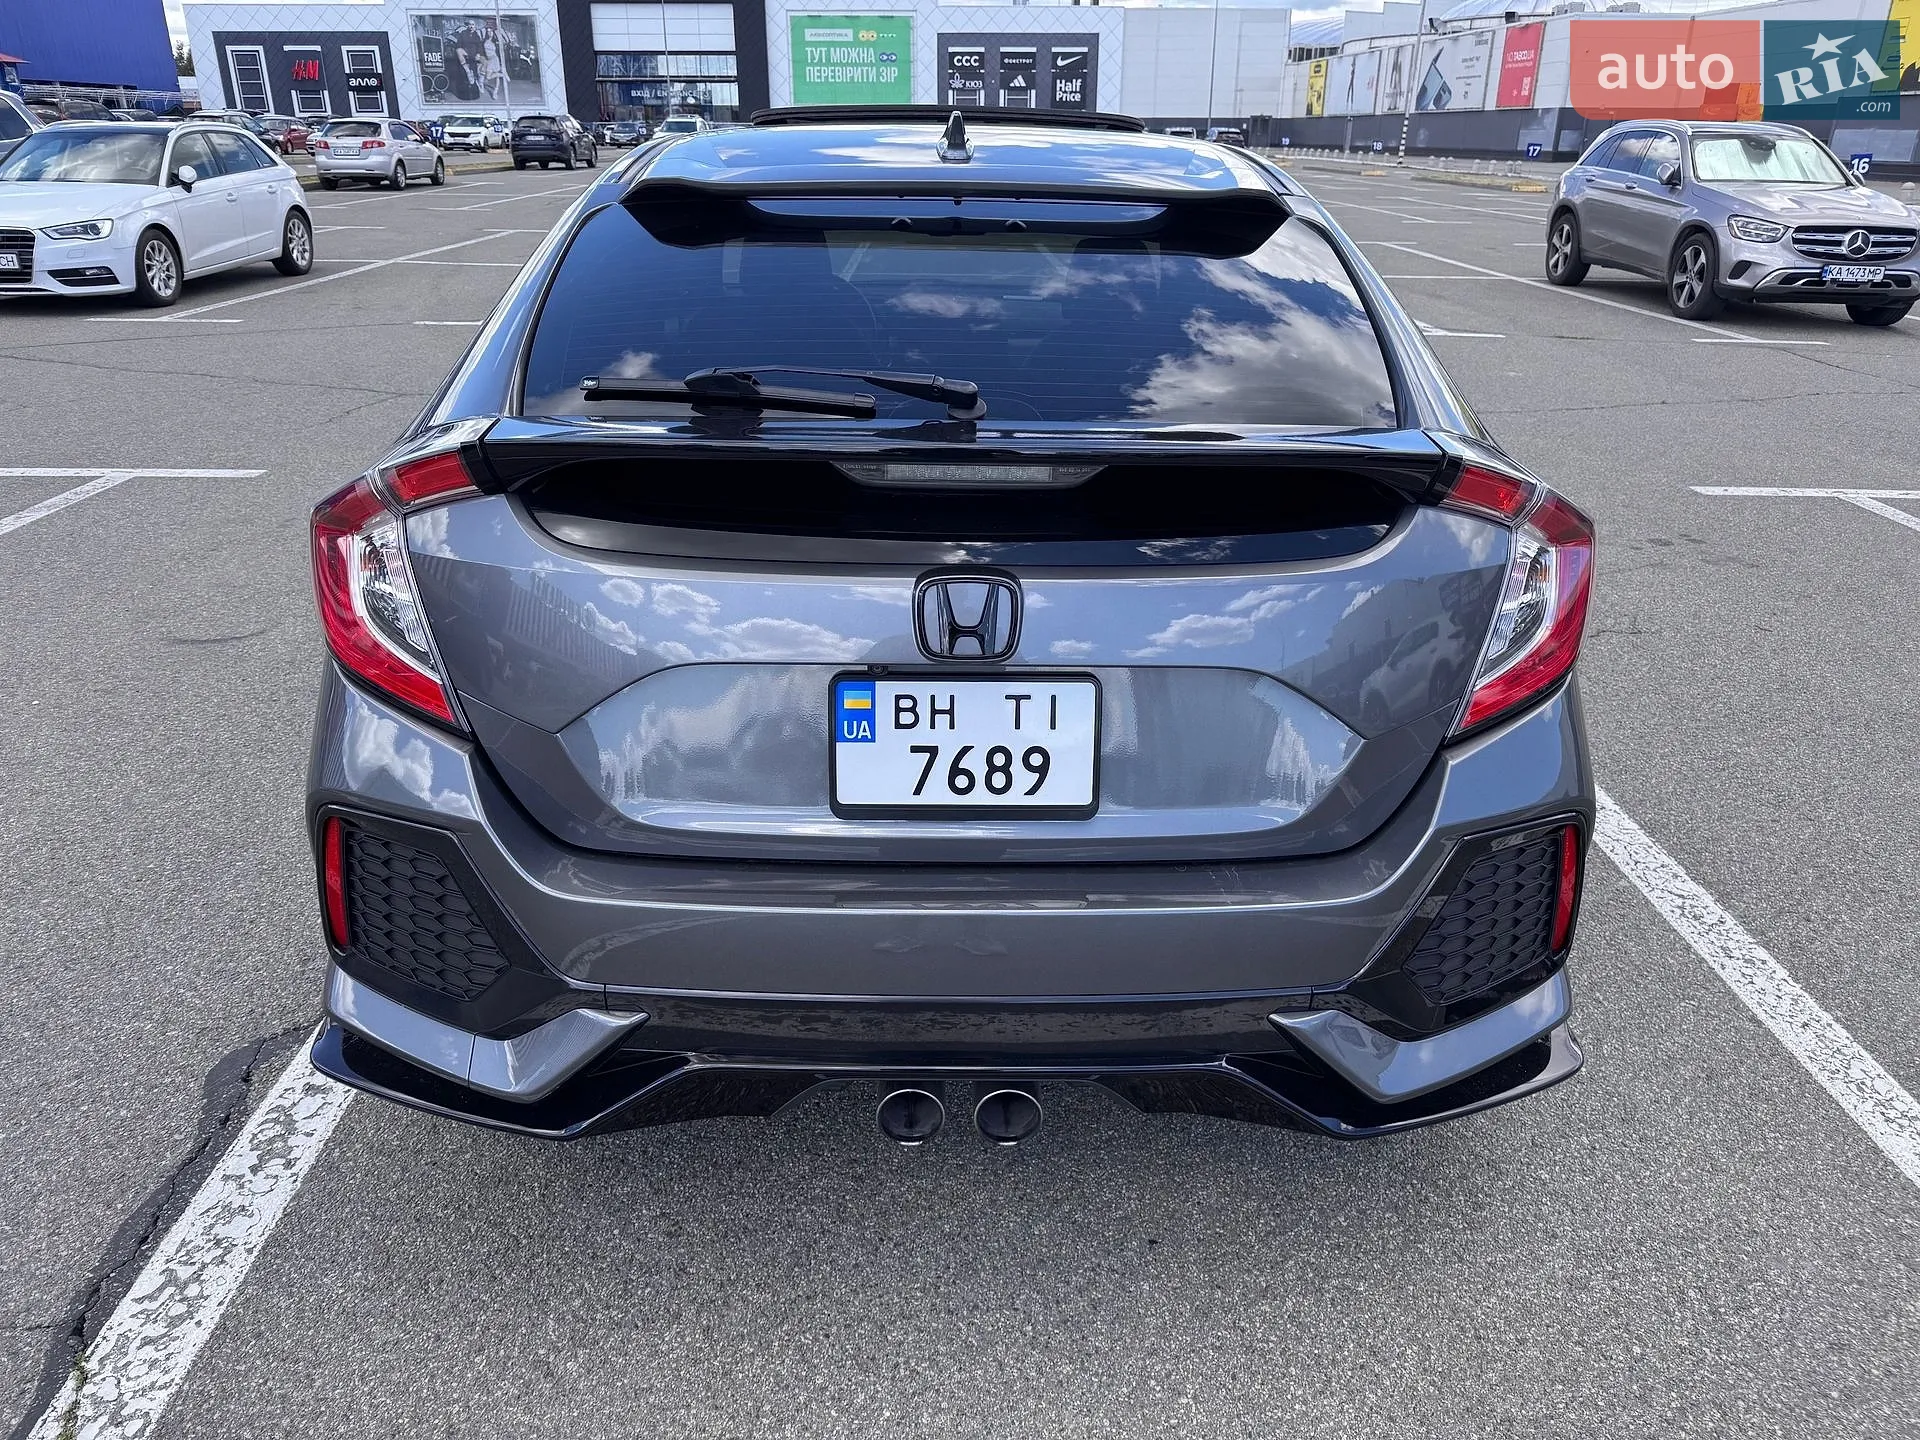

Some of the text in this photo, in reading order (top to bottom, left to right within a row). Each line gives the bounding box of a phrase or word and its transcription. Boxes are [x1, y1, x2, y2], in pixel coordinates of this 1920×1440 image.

[424, 52, 443, 62] FADE
[805, 47, 875, 63] ТУТ МОЖНА
[953, 56, 980, 66] CCC
[292, 60, 319, 80] H&M
[805, 66, 898, 82] ПЕРЕВІРИТИ ЗІР
[965, 80, 983, 88] КЮЗ
[1056, 79, 1082, 91] Half
[631, 90, 650, 98] ВХІД
[1056, 91, 1081, 101] Price
[430, 126, 443, 138] 17
[1373, 142, 1383, 151] 18
[1527, 145, 1542, 157] 17
[1850, 157, 1870, 174] 16
[1827, 266, 1882, 279] KA 1473 MP
[894, 694, 1057, 730] BH TI
[843, 720, 872, 740] UA
[910, 745, 1051, 796] 7689
